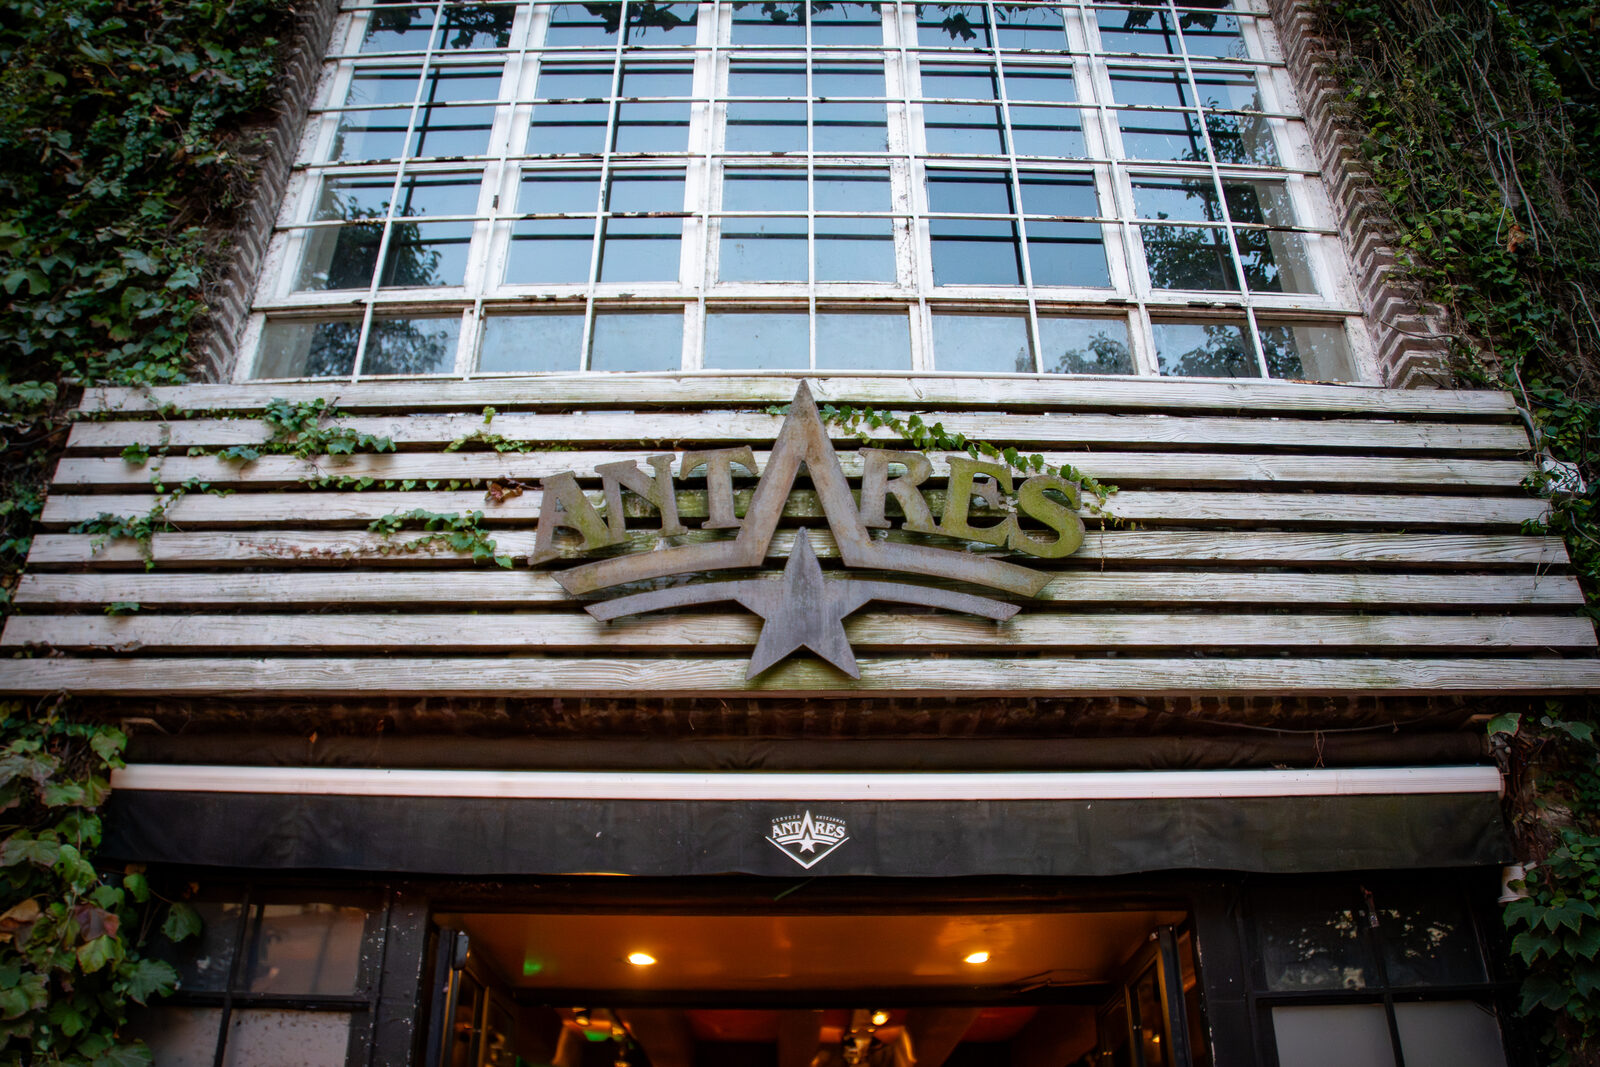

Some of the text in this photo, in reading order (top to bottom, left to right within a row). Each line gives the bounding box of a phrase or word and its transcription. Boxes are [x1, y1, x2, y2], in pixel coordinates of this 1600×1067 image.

[527, 379, 1086, 568] ANTARES
[772, 814, 800, 823] CERVEZA
[772, 810, 846, 839] ANTARES
